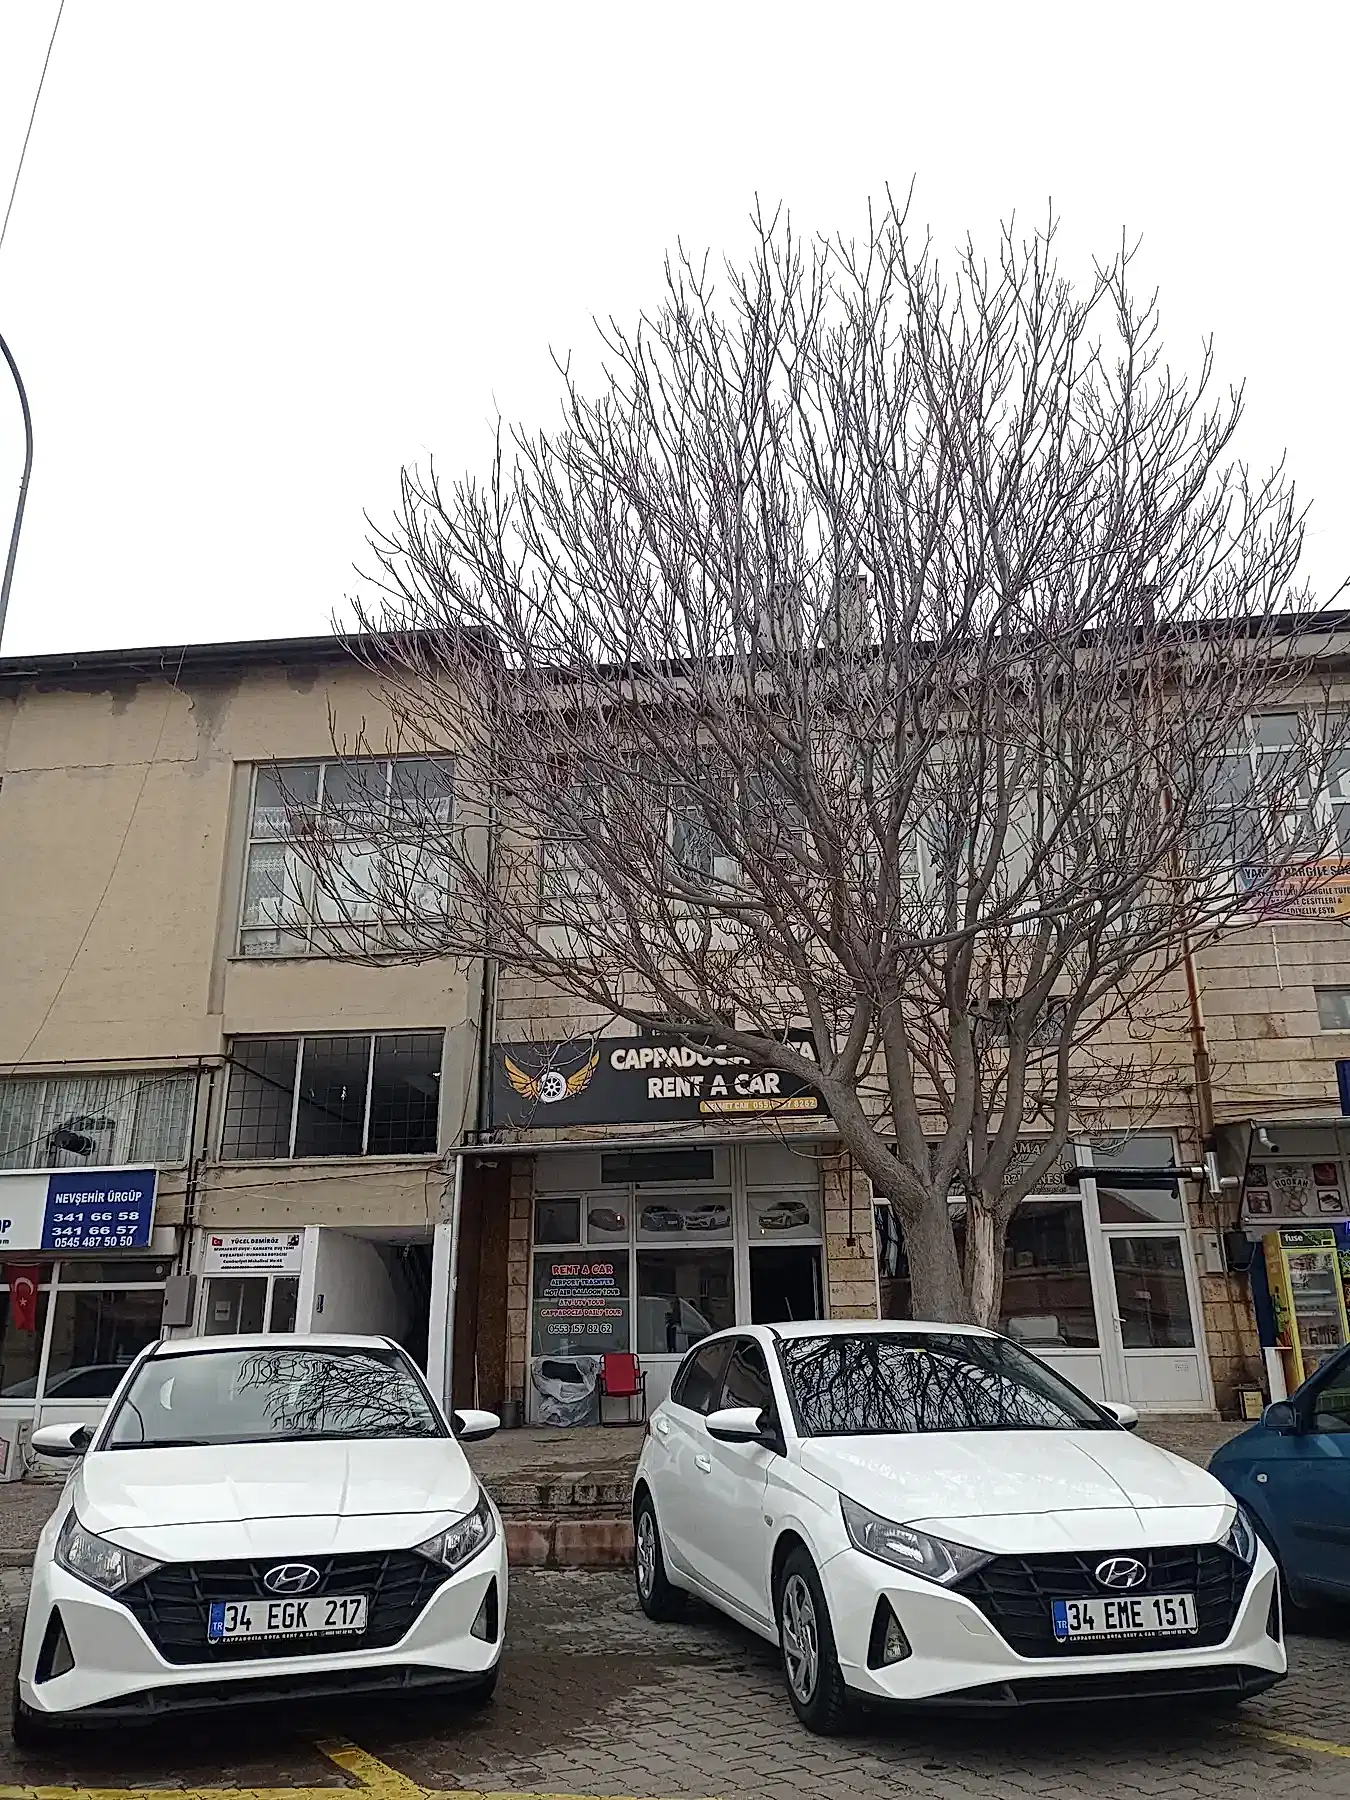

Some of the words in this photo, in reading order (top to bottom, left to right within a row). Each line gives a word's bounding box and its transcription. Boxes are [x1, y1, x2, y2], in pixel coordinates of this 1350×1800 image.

[648, 1076, 704, 1099] RENT
[710, 1074, 728, 1096] A
[734, 1072, 781, 1095] CAR
[794, 1100, 815, 1108] 8262
[1274, 1178, 1309, 1188] HOOKAH
[55, 1190, 105, 1206] NEVŞEHİR
[108, 1189, 142, 1203] ÜRGÜP
[53, 1212, 84, 1222] 341
[90, 1212, 112, 1222] 66
[118, 1212, 140, 1220] 58
[52, 1226, 82, 1236] 341
[88, 1226, 110, 1235] 66
[116, 1226, 138, 1234] 57
[54, 1237, 80, 1248] 0545
[82, 1236, 102, 1248] 487
[104, 1236, 118, 1247] 50
[120, 1236, 133, 1246] 50
[552, 1264, 580, 1275] RENT
[581, 1264, 590, 1274] A
[592, 1264, 614, 1274] CAR
[548, 1324, 570, 1334] 0553
[570, 1324, 586, 1334] 157
[586, 1324, 600, 1334] 82
[600, 1324, 612, 1334] 62
[225, 1604, 252, 1632] 34
[268, 1602, 310, 1630] EGK
[324, 1598, 362, 1626] 217
[1068, 1603, 1094, 1630] 34
[1104, 1600, 1144, 1629] EME
[1152, 1598, 1188, 1626] 151
[212, 1622, 223, 1630] TR
[1057, 1620, 1068, 1628] TR
